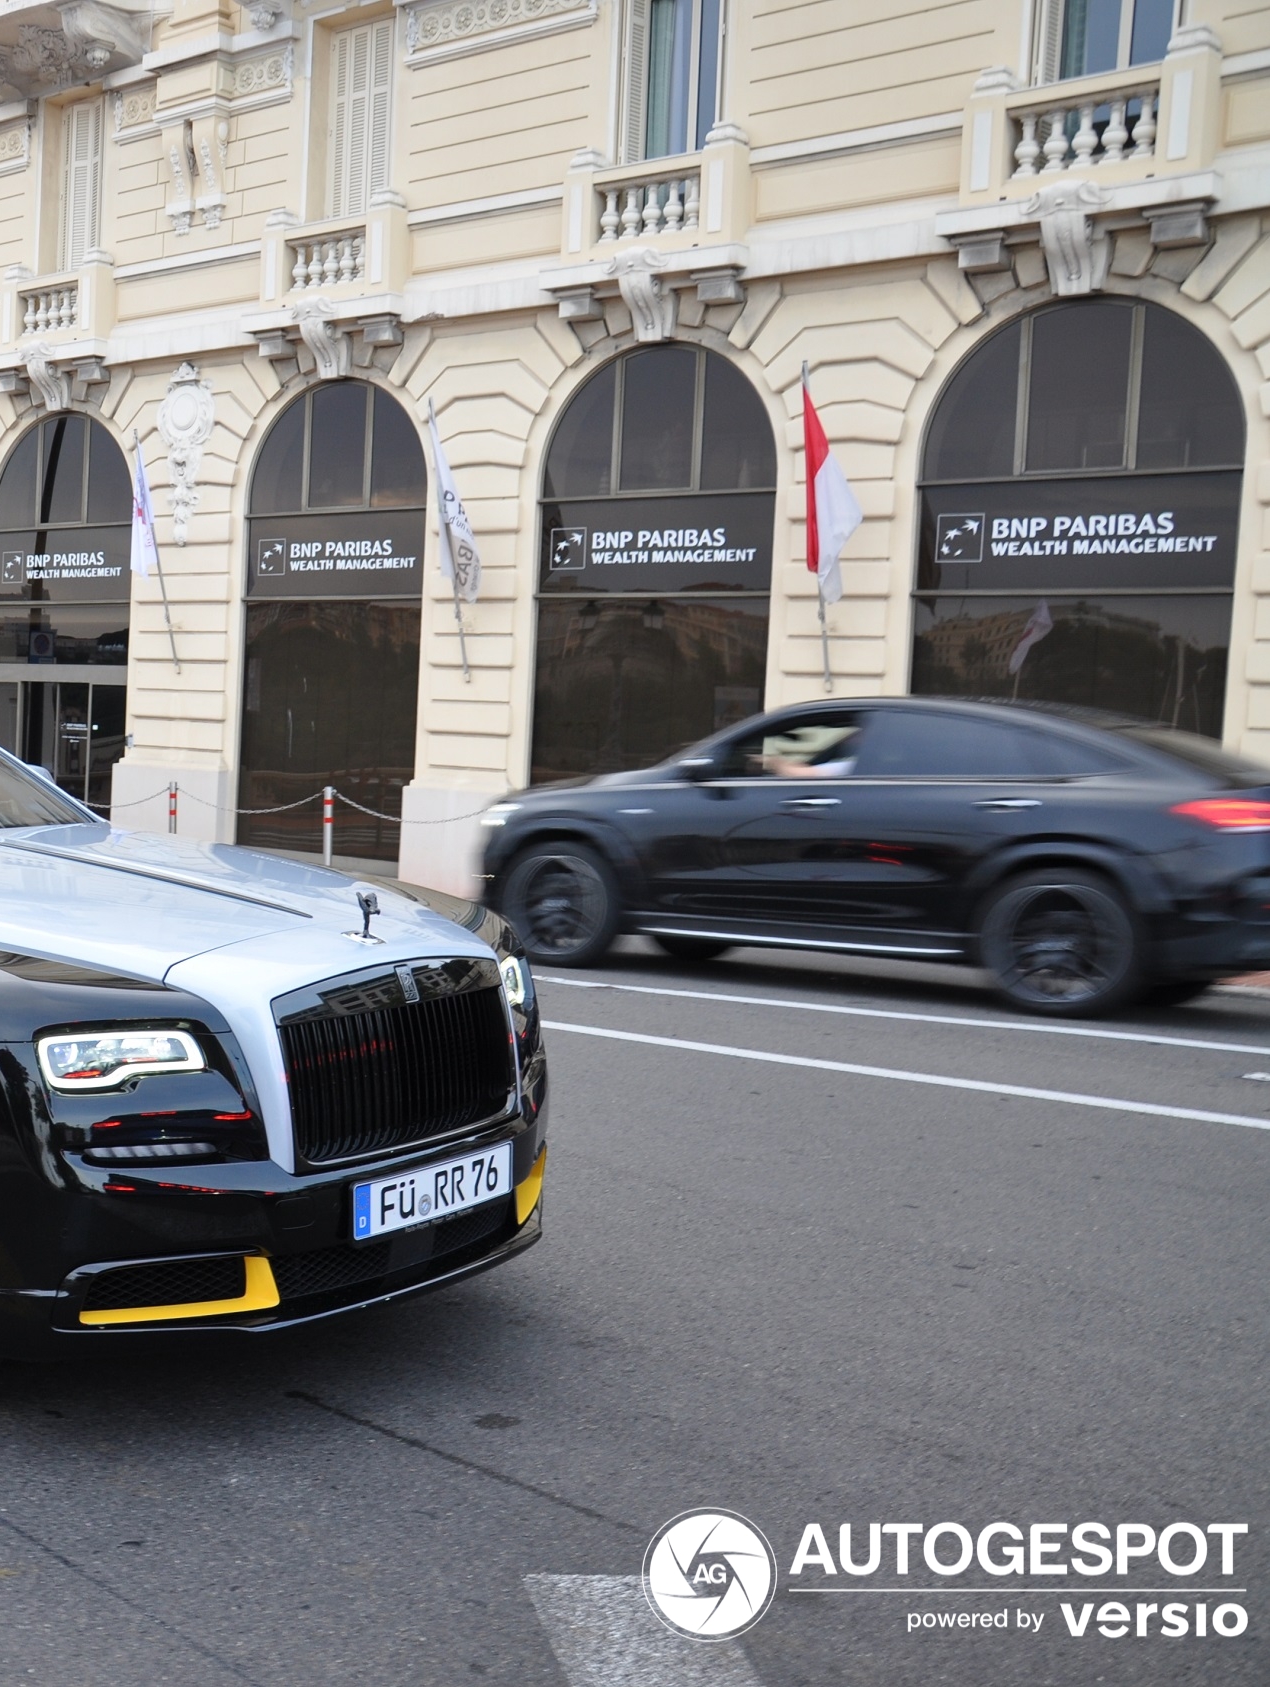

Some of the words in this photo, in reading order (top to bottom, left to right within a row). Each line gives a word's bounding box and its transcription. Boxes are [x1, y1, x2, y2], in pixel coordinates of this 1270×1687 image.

[991, 518, 1047, 539] BNP
[1053, 512, 1175, 537] PARIBAS
[591, 531, 633, 549] BNP
[637, 528, 726, 548] PARIBAS
[991, 540, 1067, 557] WEALTH
[1072, 536, 1217, 555] MANAGEMENT
[290, 542, 322, 559] BNP
[325, 539, 393, 557] PARIBAS
[591, 550, 649, 564] WEALTH
[651, 548, 757, 563] MANAGEMENT
[26, 554, 51, 568] BNP
[53, 551, 104, 567] PARIBAS
[290, 558, 334, 571] WEALTH
[336, 556, 416, 570] MANAGEMENT
[26, 568, 60, 579] WEALTH
[61, 567, 122, 578] MANAGEMENT
[381, 1179, 416, 1226] FÜ
[434, 1165, 465, 1210] RR
[472, 1154, 498, 1197] 76
[359, 1216, 367, 1229] D
